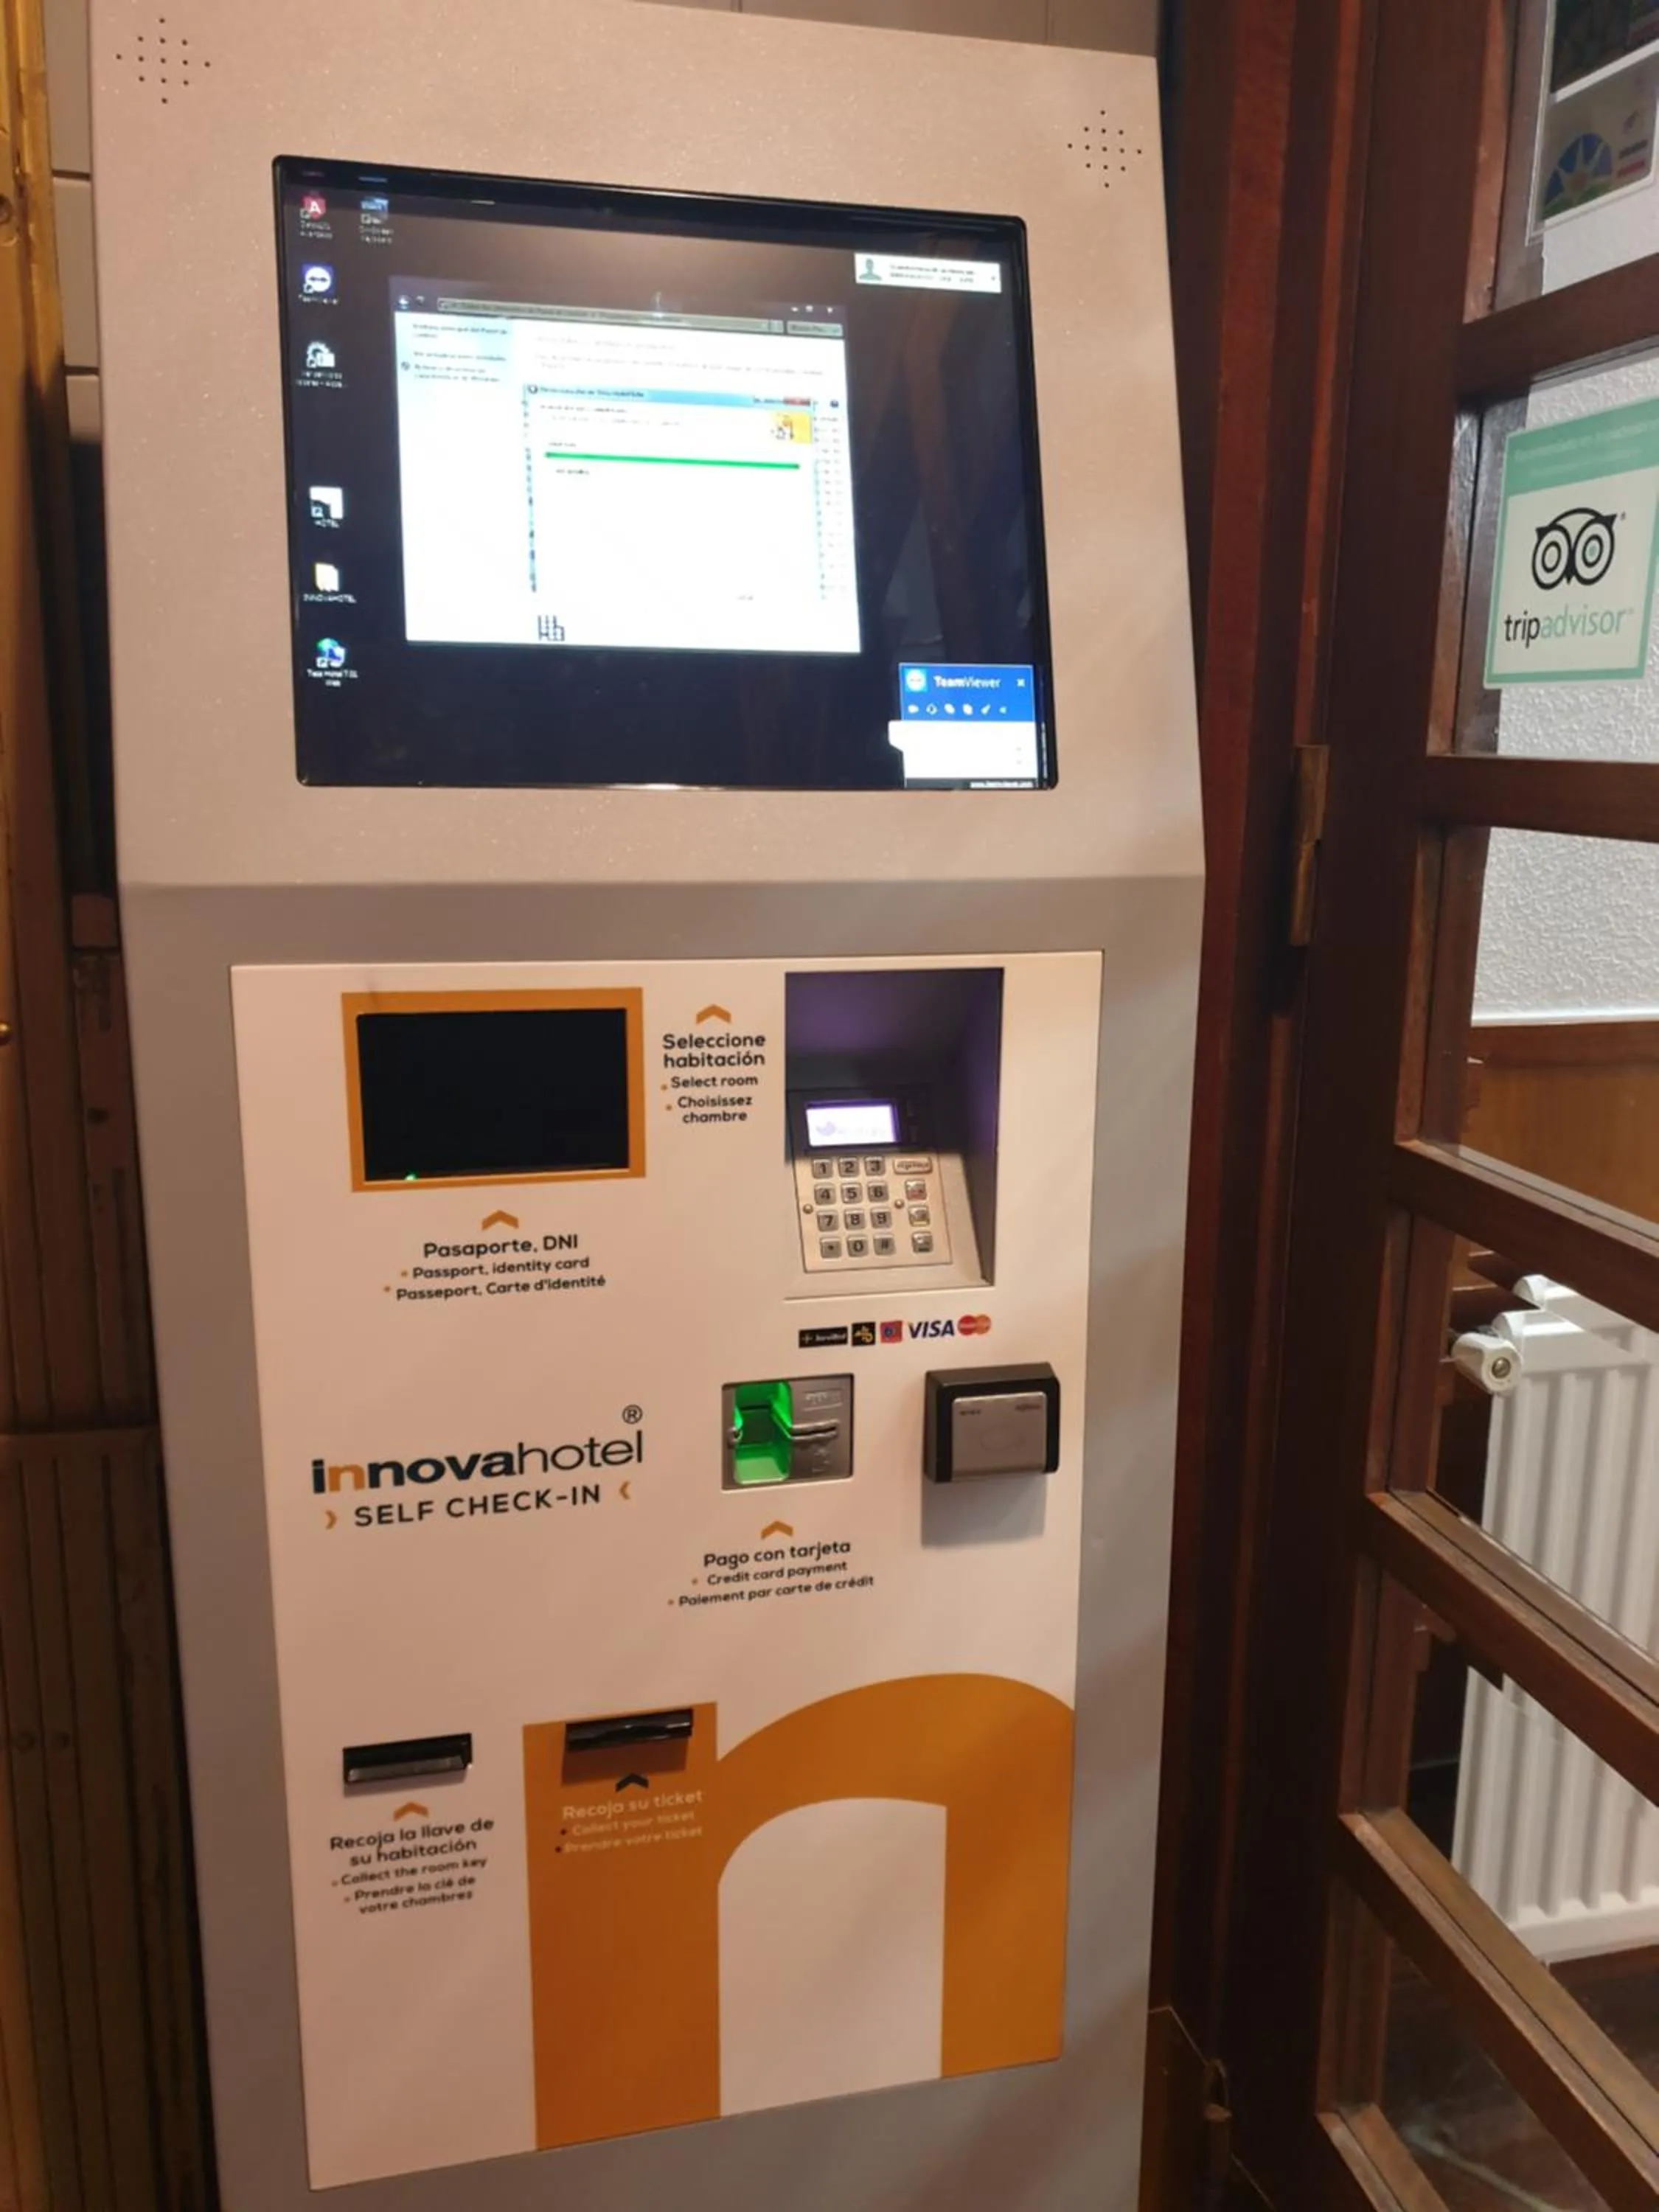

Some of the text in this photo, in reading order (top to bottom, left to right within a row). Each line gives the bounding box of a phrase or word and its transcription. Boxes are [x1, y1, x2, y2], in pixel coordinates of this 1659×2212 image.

[1504, 604, 1627, 648] tripadvisor
[933, 675, 1001, 689] TeamViewer
[662, 1033, 766, 1049] Seleccione
[663, 1050, 765, 1068] habitación
[671, 1076, 759, 1088] Select room
[677, 1094, 753, 1108] Choisissez
[682, 1110, 748, 1124] chambre
[844, 1161, 855, 1172] 2
[870, 1160, 881, 1172] 3
[821, 1189, 831, 1200] 4
[847, 1187, 858, 1199] 5
[822, 1215, 834, 1227] 7
[849, 1214, 860, 1225] 8
[542, 1234, 578, 1251] DNI
[492, 1259, 552, 1274] identity
[554, 1256, 590, 1270] card
[485, 1281, 530, 1295] Carte
[908, 1319, 955, 1339] VISA
[311, 1429, 644, 1495] innovahotel
[354, 1484, 601, 1528] SELF CHECK-IN
[703, 1541, 851, 1570] Pago con tarjeta
[707, 1561, 847, 1585] Credit card payment
[678, 1576, 874, 1607] Paiement par carte de crédit
[563, 1790, 703, 1820] Recoja su ticket
[330, 1818, 494, 1851] Recoja la llave de
[349, 1838, 478, 1867] su habitación
[341, 1857, 487, 1885] Collect the room key
[354, 1875, 476, 1901] Prendre la clé de
[358, 1890, 473, 1914] votre chambres
